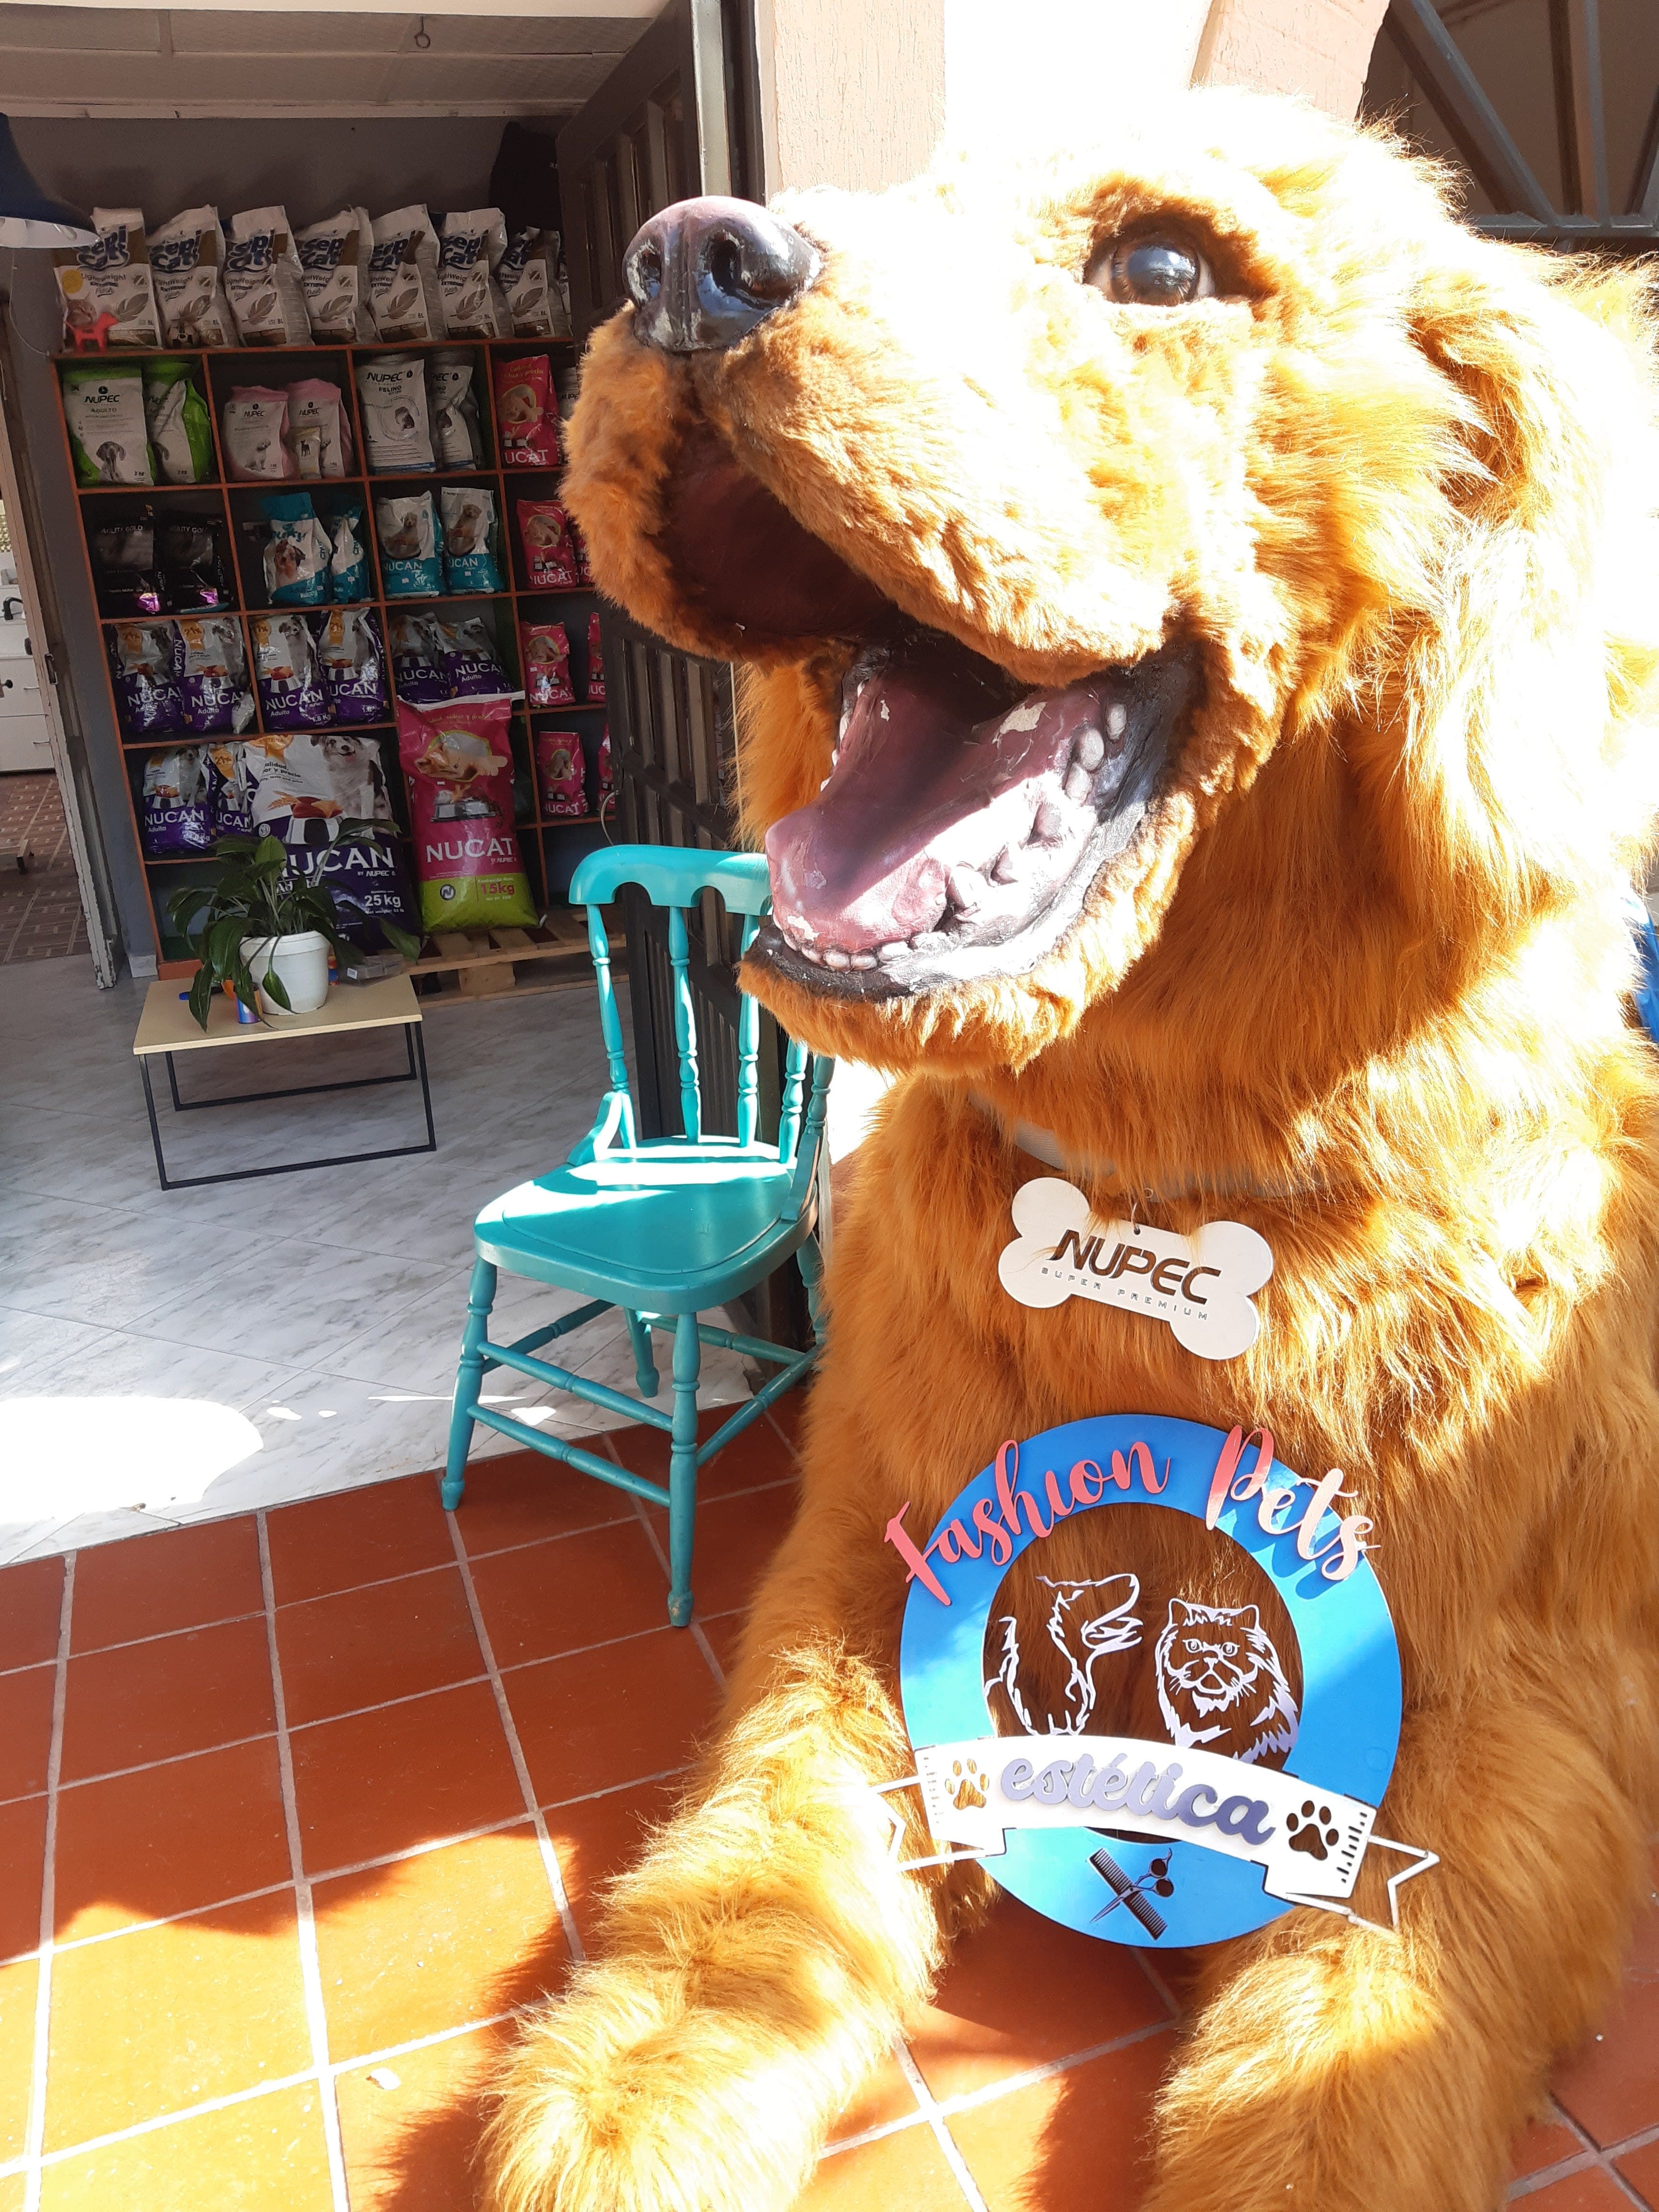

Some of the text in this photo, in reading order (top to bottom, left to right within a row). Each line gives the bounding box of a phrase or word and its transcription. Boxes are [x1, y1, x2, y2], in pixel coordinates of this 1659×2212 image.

[366, 372, 403, 383] NUPEC
[84, 395, 120, 404] NUPEC
[300, 408, 320, 416] NUPEC
[461, 674, 482, 683] Adulto
[265, 688, 324, 710] NUCAN
[264, 762, 289, 770] alidad,
[280, 769, 301, 778] precio
[144, 809, 204, 826] NUCAN
[426, 837, 513, 863] NUCAT
[282, 847, 396, 878] UCAN
[363, 894, 401, 908] 25 kg
[1046, 1229, 1222, 1305] NUPEC
[1041, 1267, 1208, 1321] SUPER PREMIUM
[884, 1424, 1382, 1606] Fashion Pets
[1000, 1753, 1276, 1846] estética
